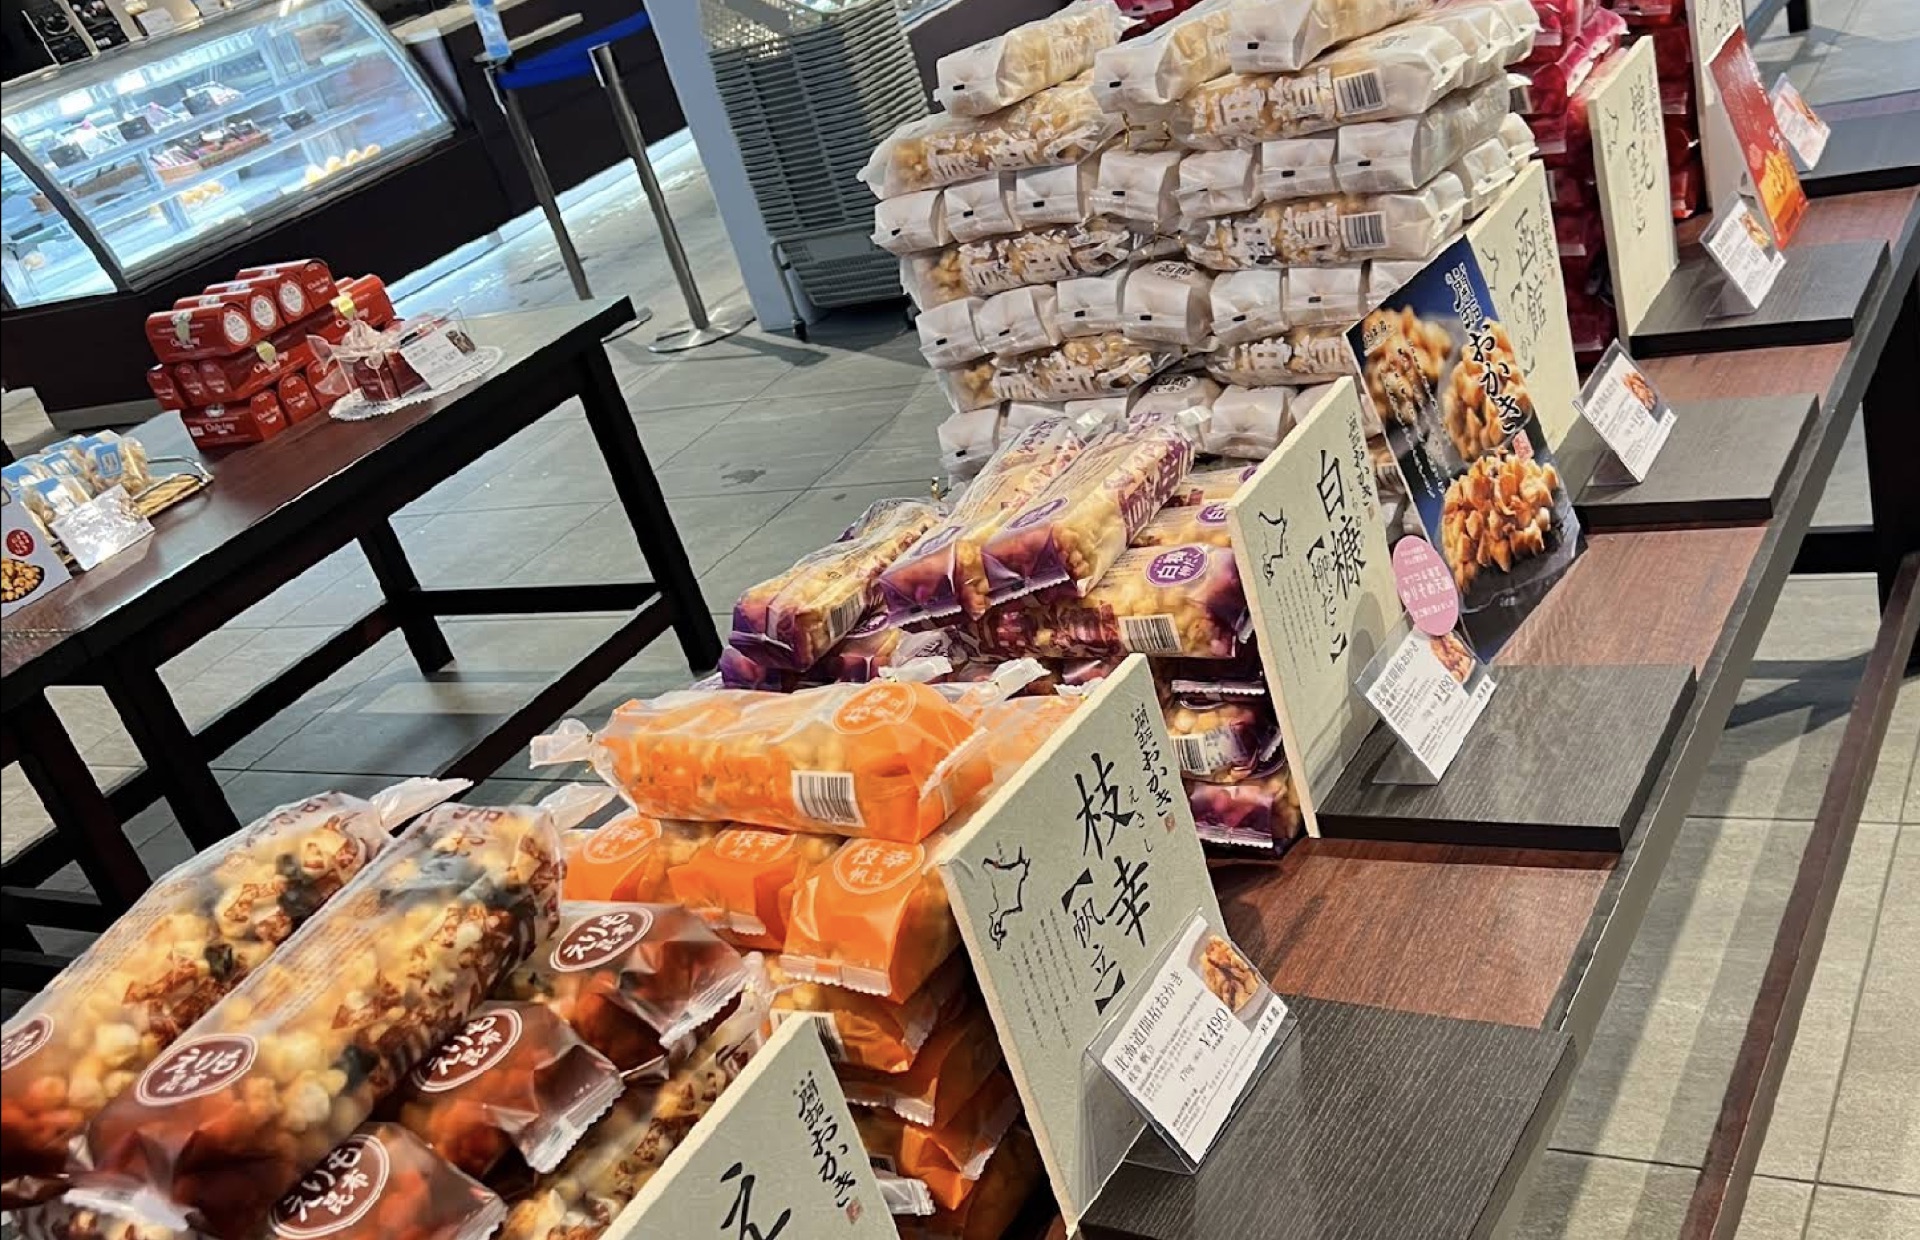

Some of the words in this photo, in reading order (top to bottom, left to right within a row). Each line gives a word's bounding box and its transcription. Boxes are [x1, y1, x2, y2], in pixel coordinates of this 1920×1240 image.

[1074, 752, 1151, 949] 枝幸
[562, 913, 630, 961] えりも
[427, 1015, 498, 1077] えりも
[1113, 970, 1184, 1073] 北海道開拓おかき
[282, 1146, 362, 1223] えりも
[323, 1168, 370, 1216] 昆布
